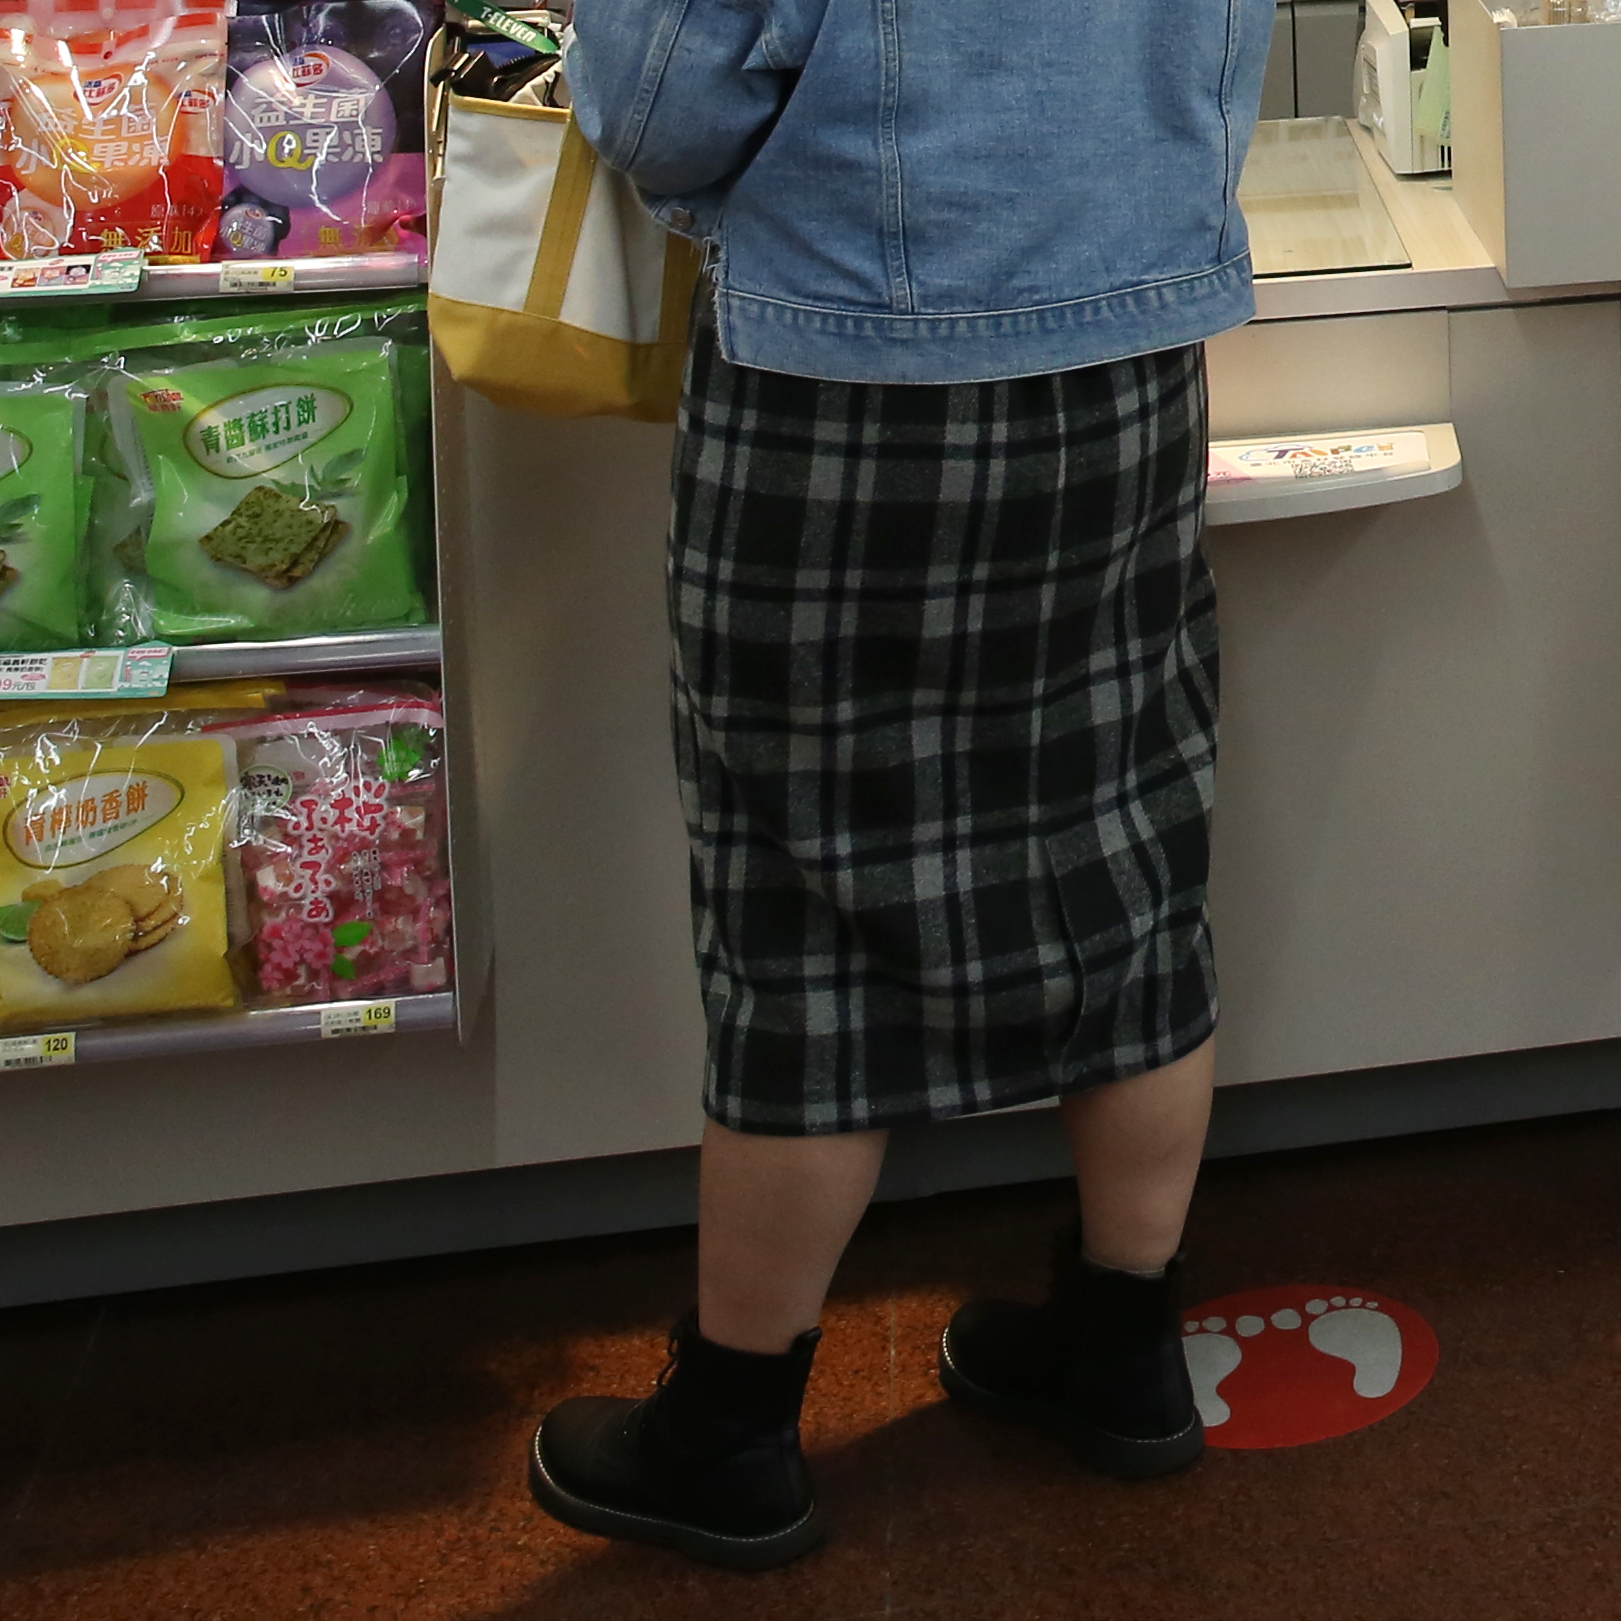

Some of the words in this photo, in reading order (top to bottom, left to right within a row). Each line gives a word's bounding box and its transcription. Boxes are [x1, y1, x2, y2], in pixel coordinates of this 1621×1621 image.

[252, 92, 370, 128] 益生菌
[229, 128, 384, 172] 小Q果凍
[267, 266, 288, 278] 75
[365, 1006, 391, 1021] 169
[44, 1037, 69, 1052] 120
